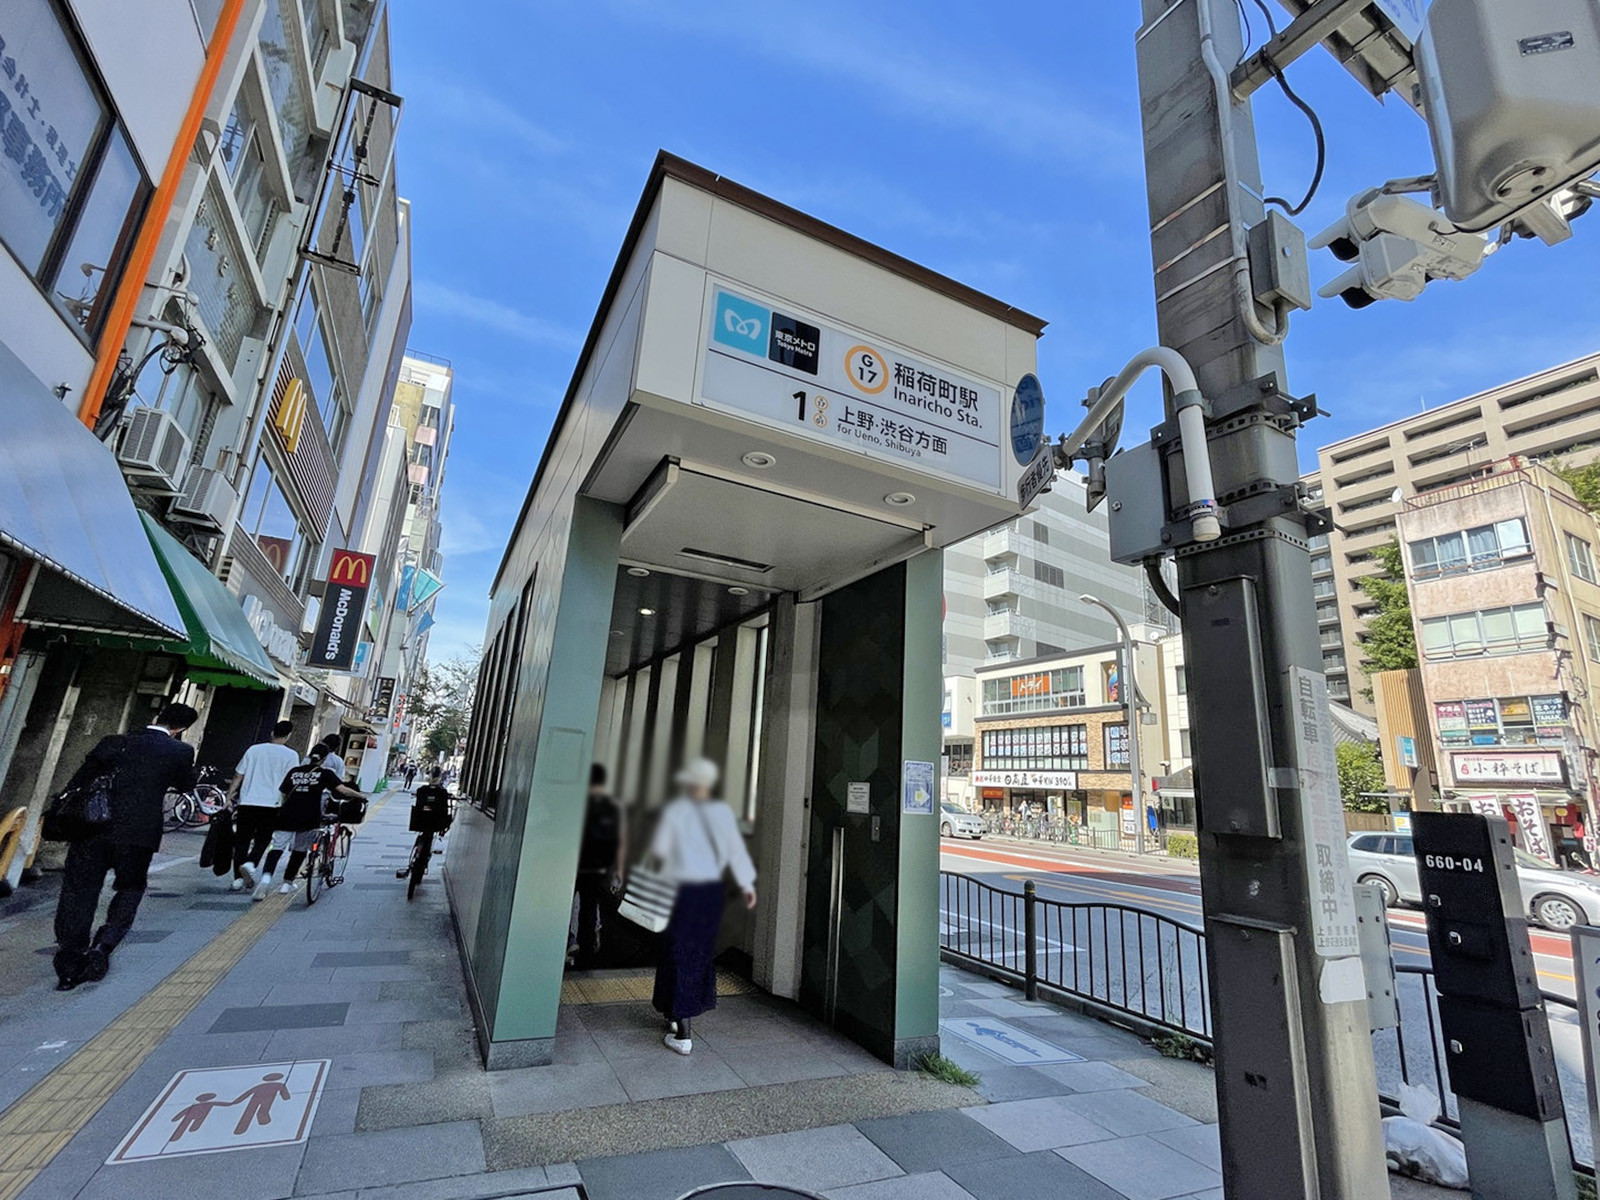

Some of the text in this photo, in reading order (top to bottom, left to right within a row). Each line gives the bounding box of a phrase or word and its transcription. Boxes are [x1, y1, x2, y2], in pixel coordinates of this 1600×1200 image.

[775, 330, 816, 352] 東京メトロ
[777, 340, 813, 357] Tokyo Metro
[858, 366, 878, 384] 17
[861, 354, 874, 367] G
[894, 362, 979, 412] 稲荷町駅
[792, 391, 806, 421] 1
[894, 387, 983, 429] Inaricho Sta.
[837, 423, 922, 458] for Ueno, Shibuya
[325, 588, 352, 660] McDonald's
[1514, 798, 1547, 855] おそば
[1425, 854, 1484, 873] 660-04
